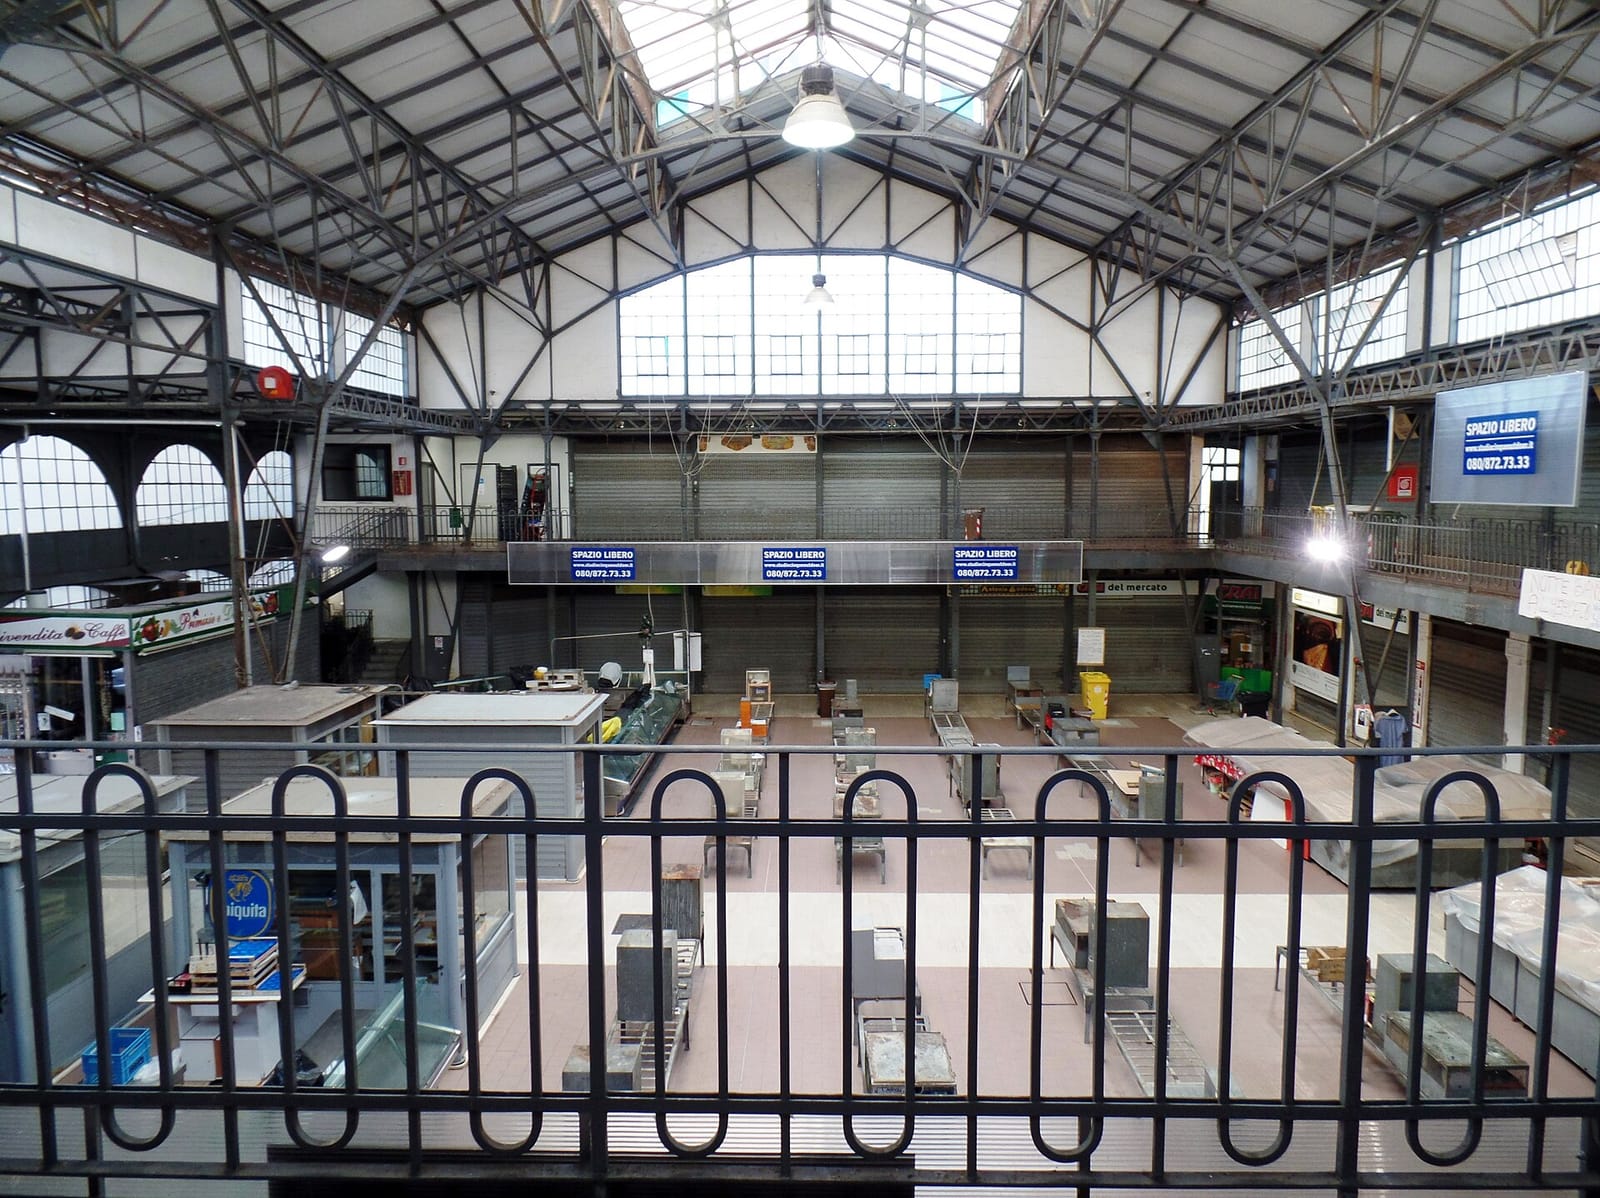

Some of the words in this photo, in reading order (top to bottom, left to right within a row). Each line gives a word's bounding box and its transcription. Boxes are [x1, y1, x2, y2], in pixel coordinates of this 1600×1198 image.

[1466, 421, 1498, 436] SPAZIO
[1499, 417, 1536, 434] LIBERO
[1466, 456, 1530, 471] 080/872.73.33
[572, 551, 602, 559] SPAZIO
[603, 551, 634, 559] LIBERO
[763, 551, 793, 559] SPAZIO
[795, 551, 825, 559] LIBERO
[955, 550, 985, 558] SPAZIO
[986, 550, 1017, 558] LIBERO
[575, 570, 631, 578] 080/872.73.33
[766, 570, 822, 578] 080/872.73.33
[957, 569, 1014, 577] 080/872.73.33
[1107, 583, 1124, 592] del
[1126, 584, 1168, 592] mercato
[0, 627, 64, 642] ivendita
